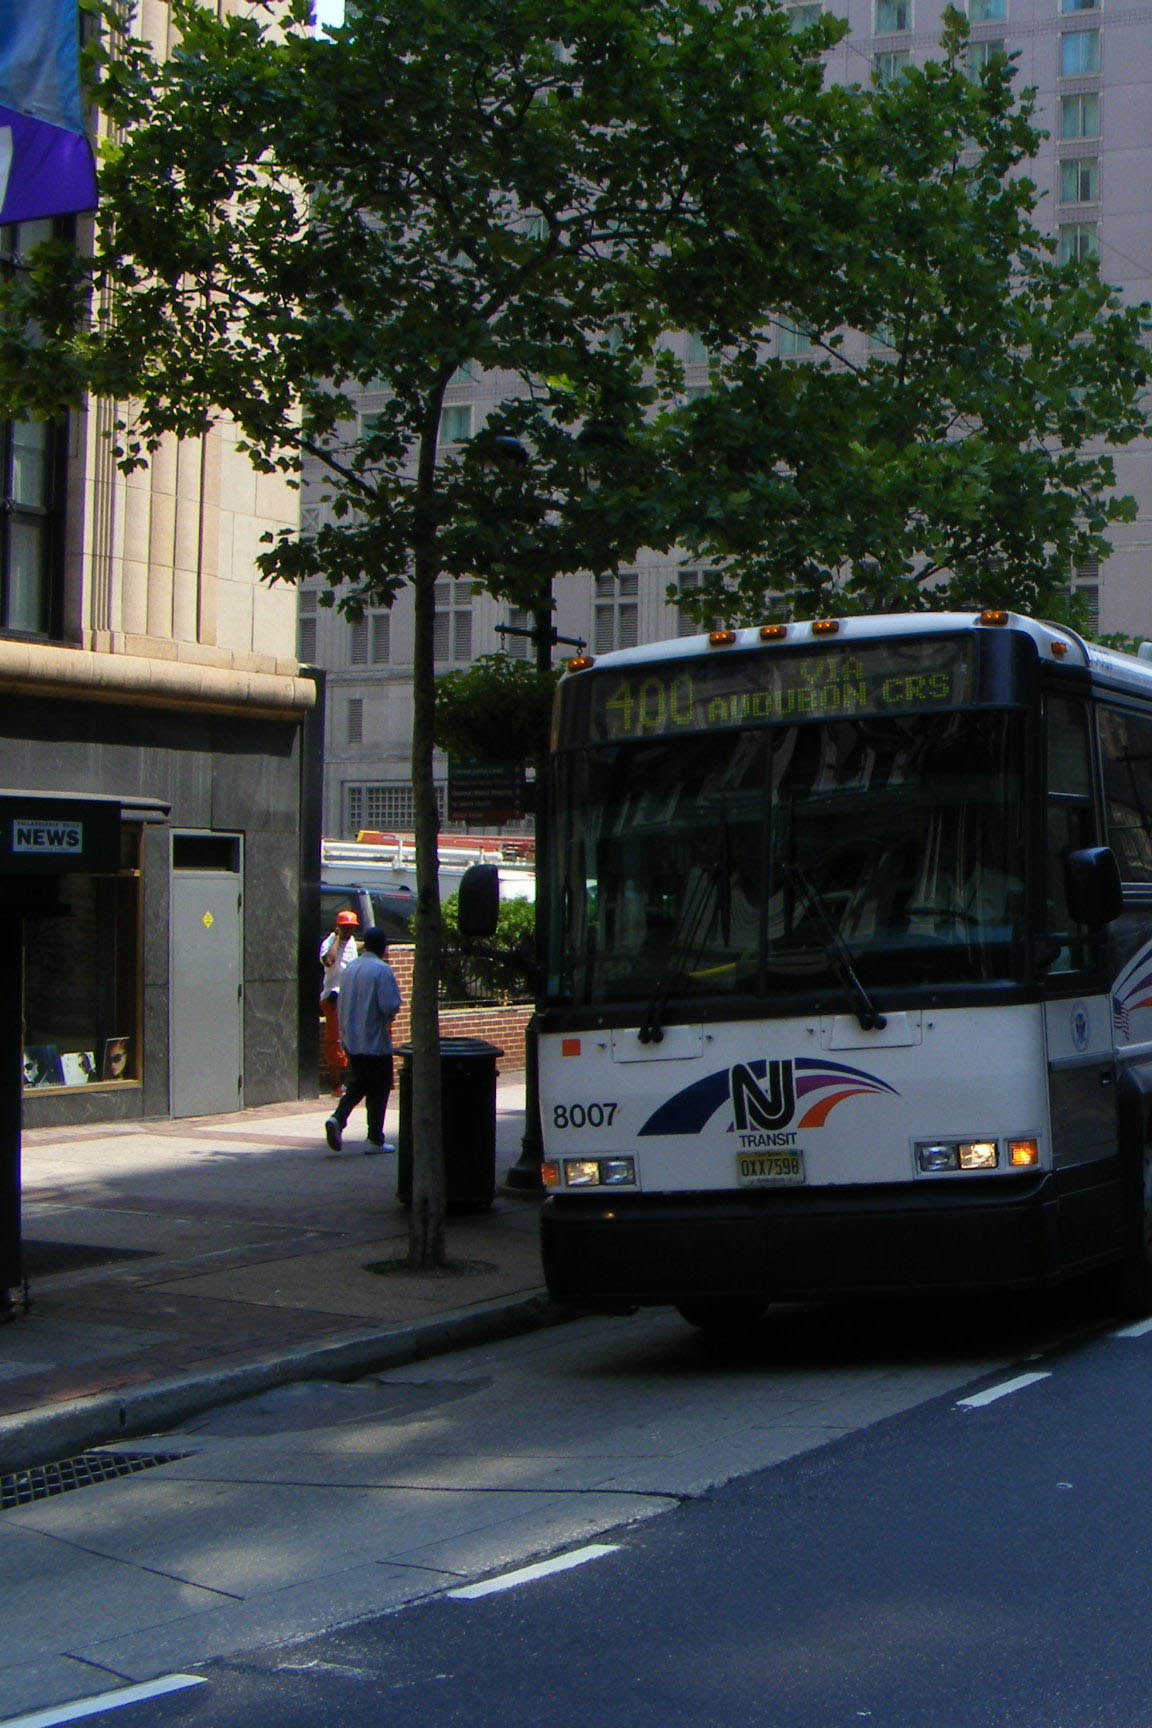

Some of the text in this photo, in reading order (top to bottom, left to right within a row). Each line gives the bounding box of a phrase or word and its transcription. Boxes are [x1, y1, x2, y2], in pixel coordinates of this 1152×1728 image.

[800, 656, 864, 683] VIA
[605, 673, 694, 731] 400
[708, 672, 951, 722] AUDUBON CRS
[17, 828, 80, 847] NEWS
[731, 1059, 796, 1131] NJ
[553, 1103, 618, 1129] 8007
[738, 1132, 798, 1149] TRANSIT
